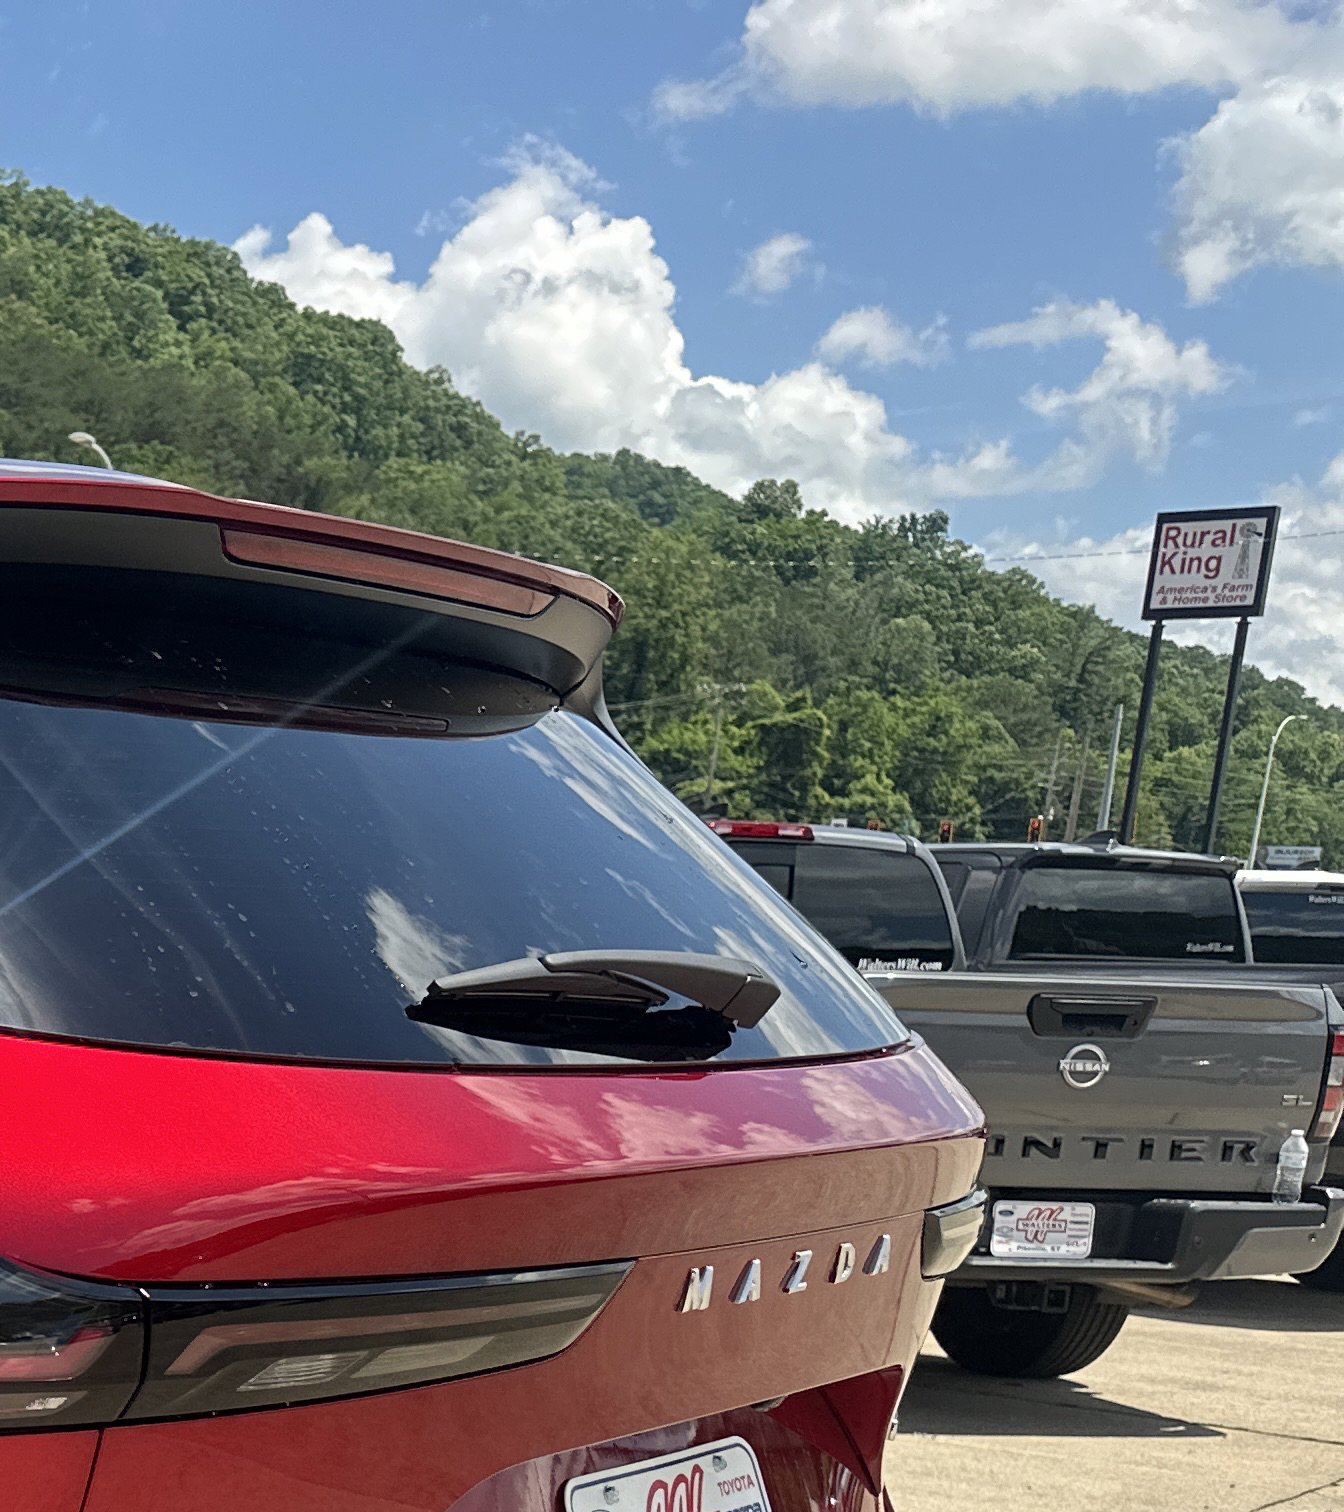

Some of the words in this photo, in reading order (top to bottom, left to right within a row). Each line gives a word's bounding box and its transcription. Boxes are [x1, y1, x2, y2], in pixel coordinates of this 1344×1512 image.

[1163, 523, 1237, 549] Rural
[1159, 551, 1222, 580] King
[1156, 584, 1218, 595] America's
[1221, 582, 1254, 593] Farm
[1159, 596, 1168, 605] &
[1172, 594, 1210, 605] Home
[1213, 593, 1247, 604] Store
[1059, 1059, 1110, 1073] NISSAN
[1281, 1094, 1312, 1107] SL
[674, 1233, 891, 1313] MAZDA
[717, 1474, 755, 1498] TOYOTA
